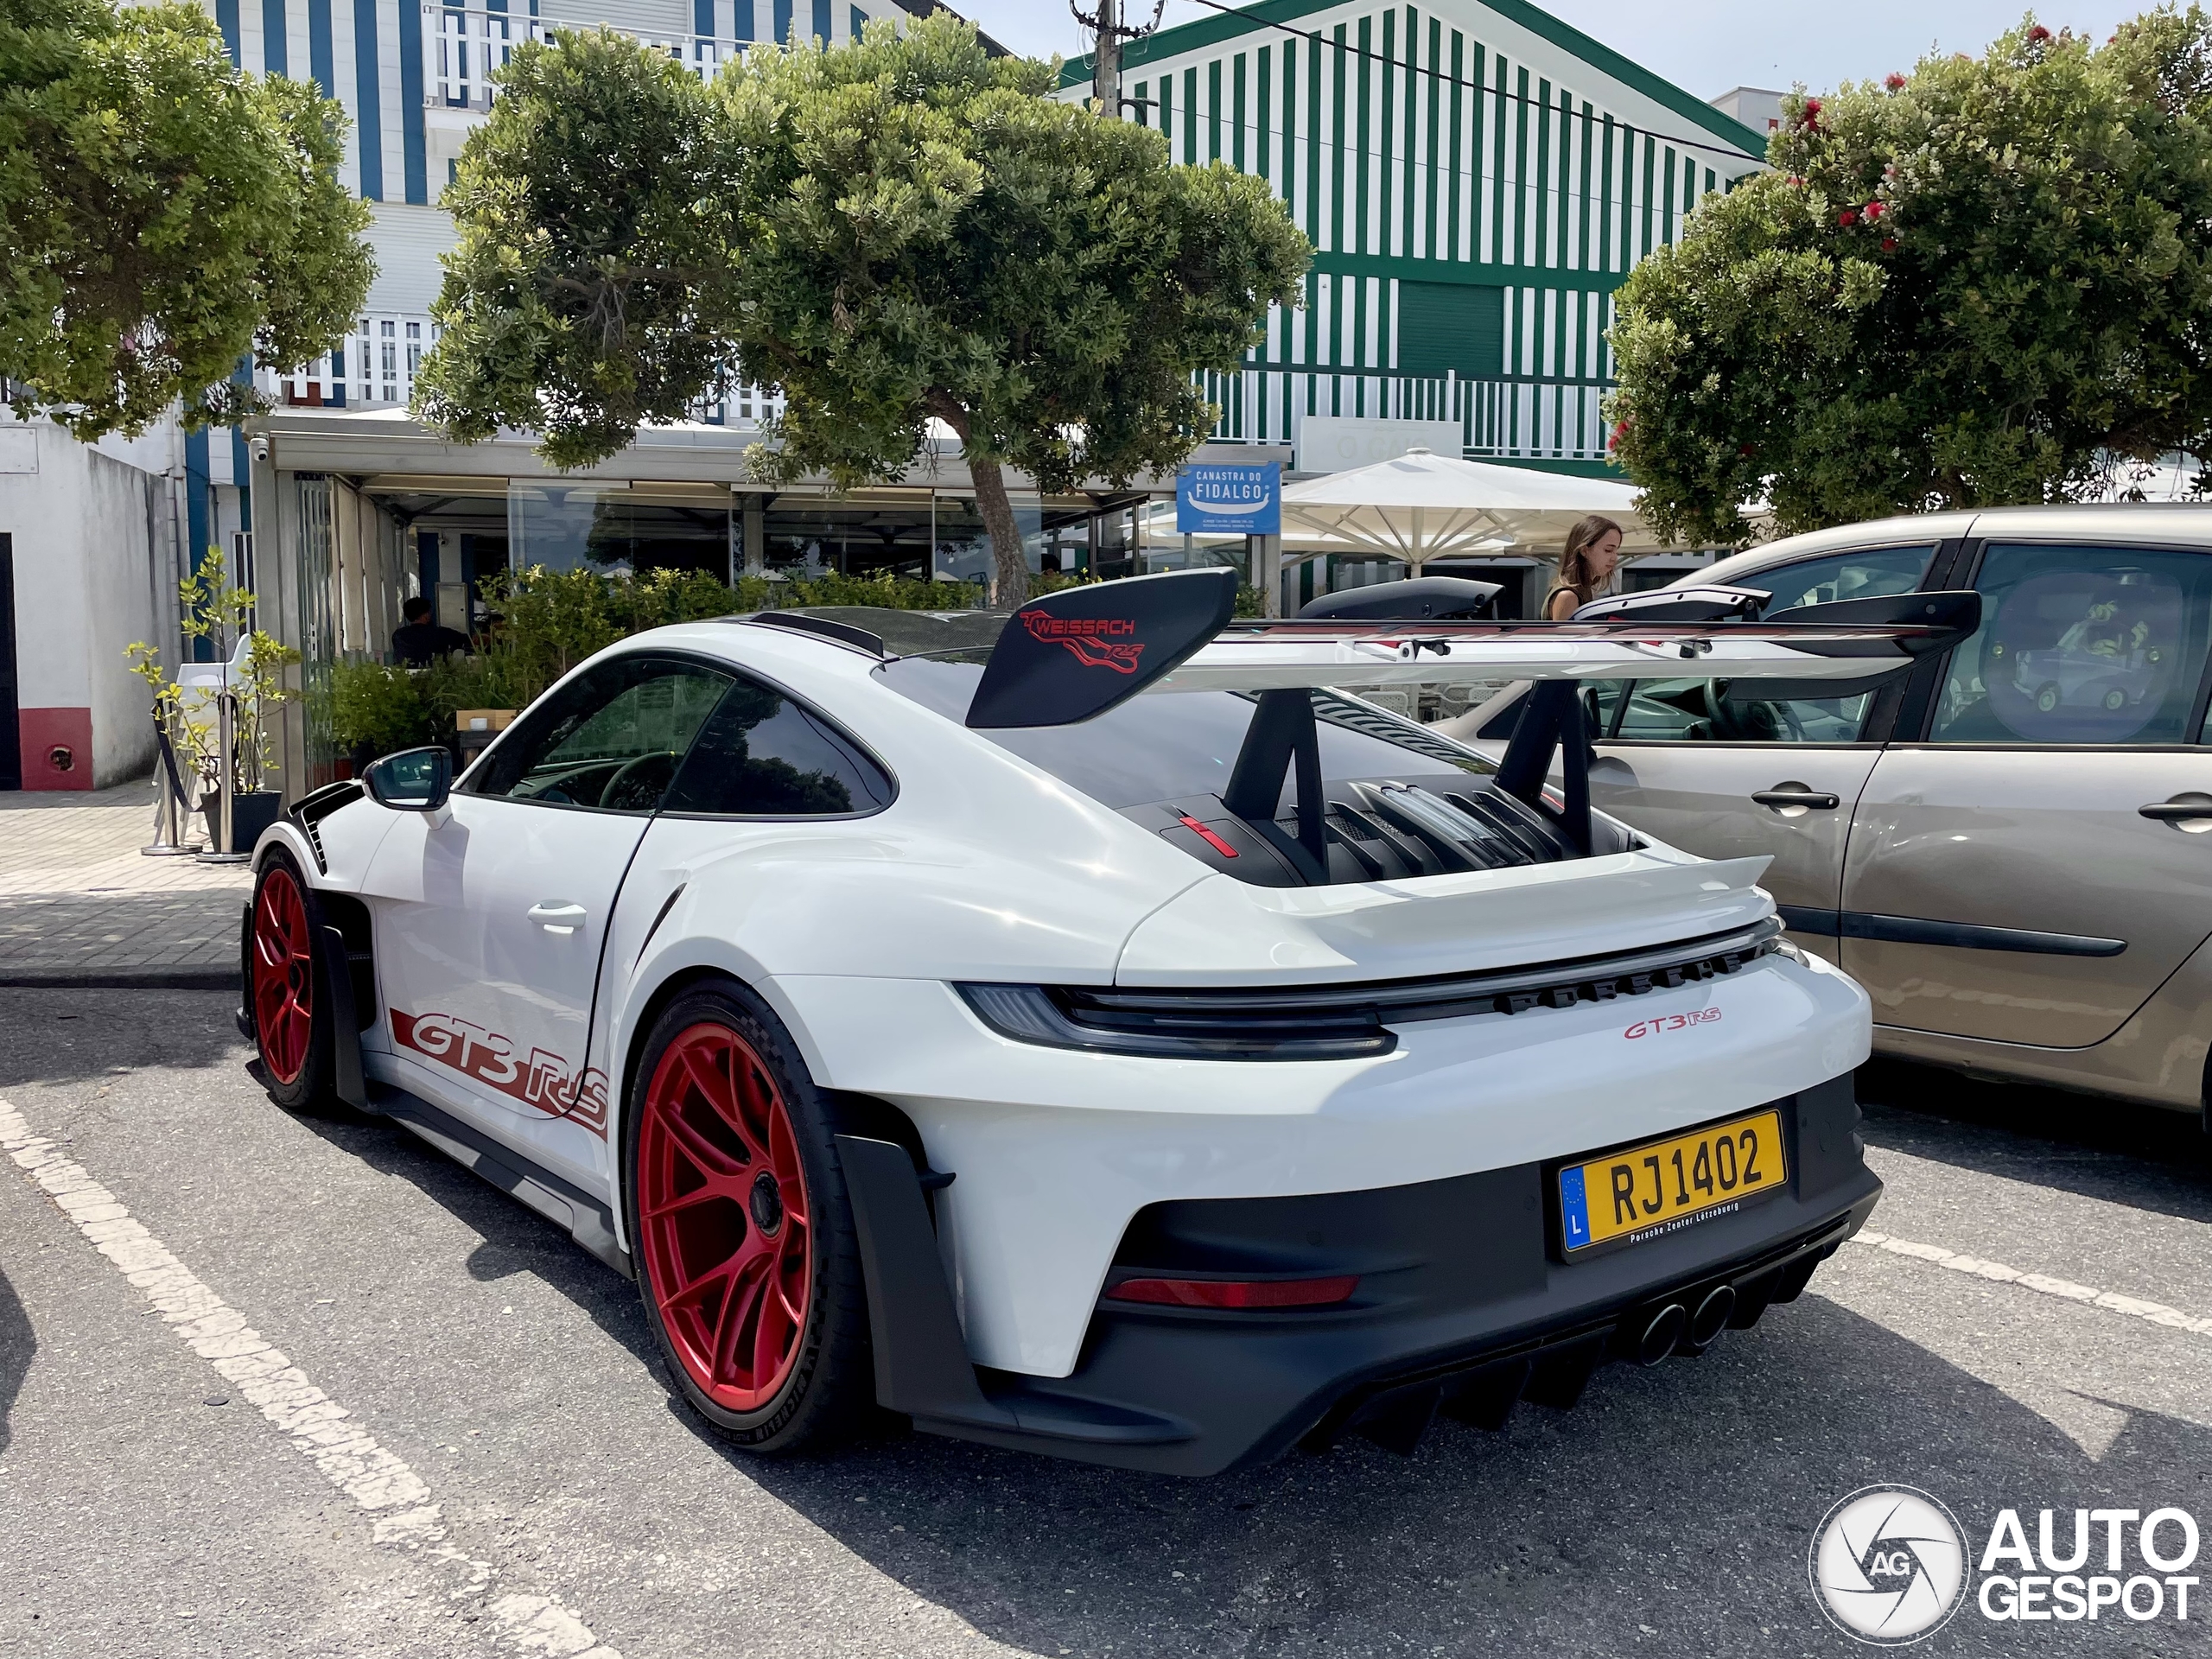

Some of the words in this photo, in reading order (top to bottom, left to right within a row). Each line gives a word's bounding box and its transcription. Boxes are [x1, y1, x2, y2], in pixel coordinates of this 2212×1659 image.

[1196, 471, 1244, 481] CANASTRA
[1249, 473, 1261, 481] DO
[1196, 484, 1261, 499] FIDALGO
[1037, 620, 1135, 635] WEISSACH
[1611, 1128, 1762, 1225] RJ1402
[1571, 1215, 1581, 1235] L
[1630, 1227, 1663, 1243] Porsche
[1667, 1217, 1693, 1231] Zenter
[755, 1374, 807, 1441] MICHELIN
